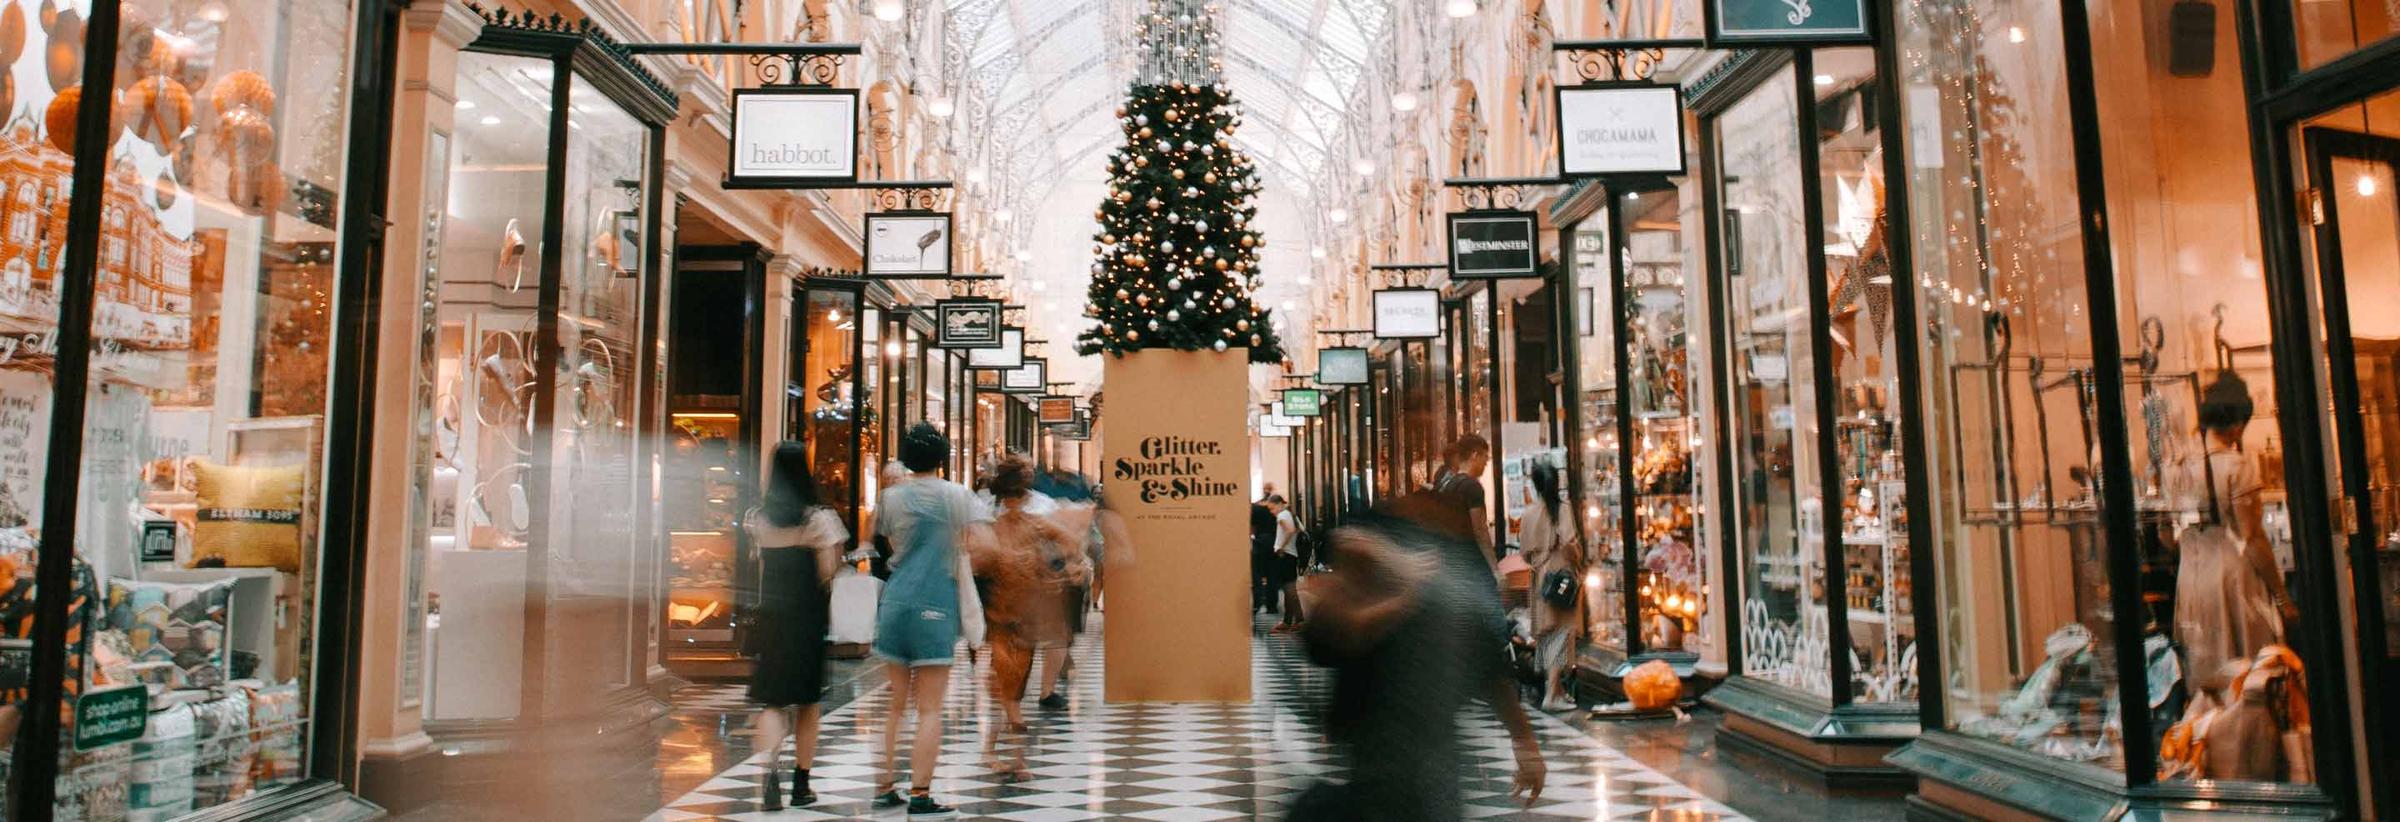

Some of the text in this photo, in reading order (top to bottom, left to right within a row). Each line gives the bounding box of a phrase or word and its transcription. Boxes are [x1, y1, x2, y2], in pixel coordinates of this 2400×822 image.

[1577, 127, 1658, 144] CHOCAMAMA
[752, 143, 837, 164] habbot.
[1140, 436, 1221, 460] Glitter.
[1115, 457, 1204, 481] Sparkle
[1140, 477, 1238, 503] & Shine
[211, 508, 294, 520] ELTHAM 3095
[111, 696, 139, 715] online
